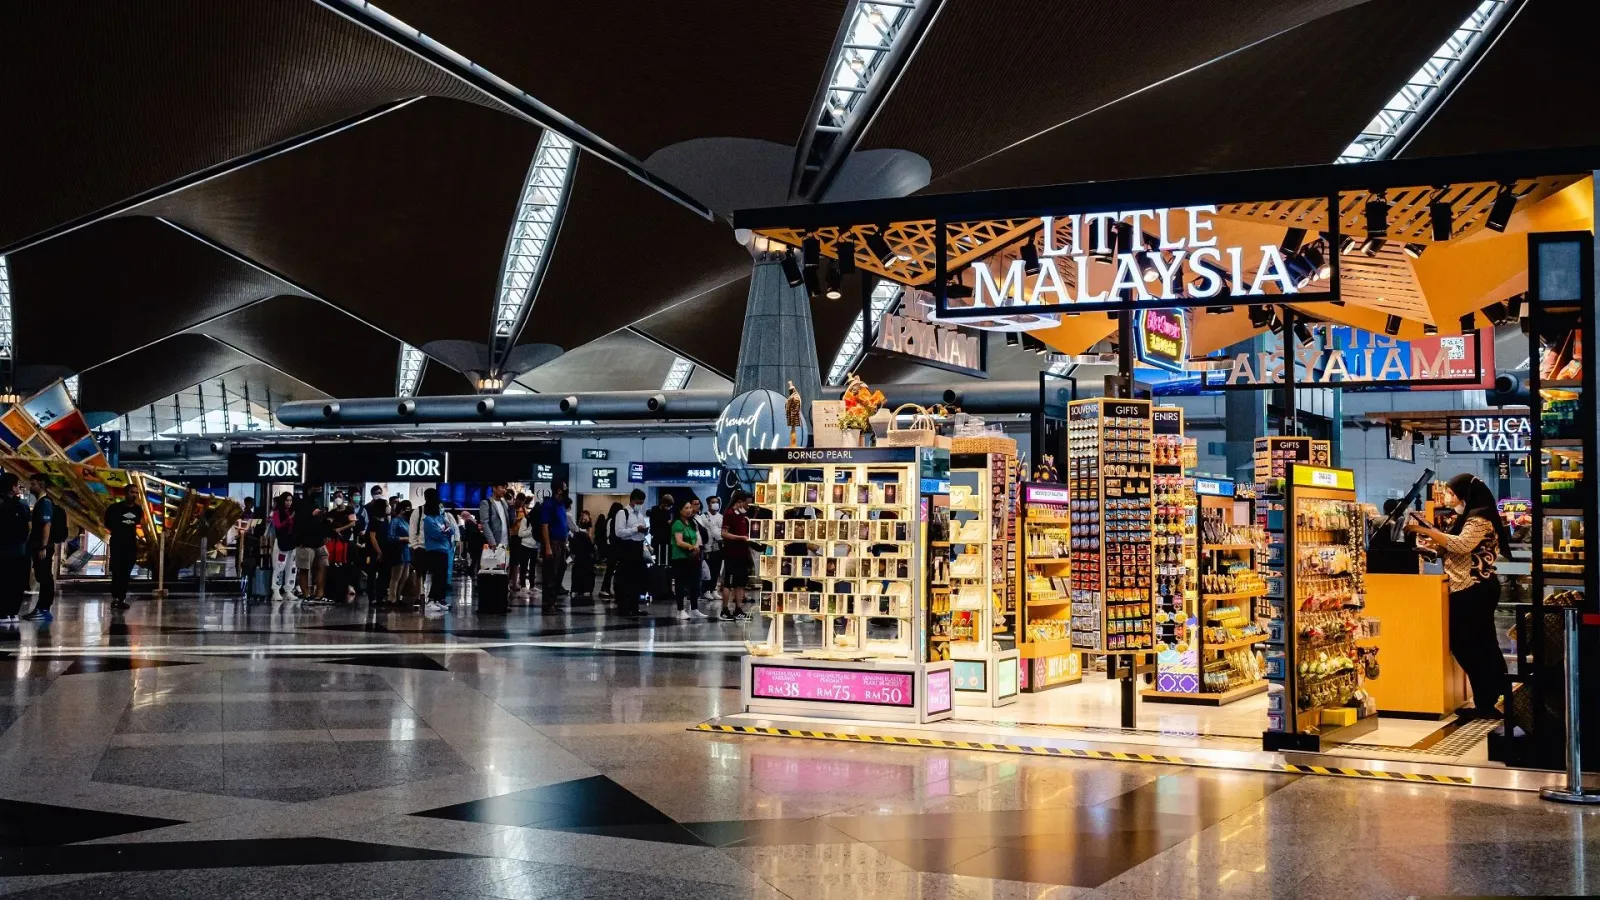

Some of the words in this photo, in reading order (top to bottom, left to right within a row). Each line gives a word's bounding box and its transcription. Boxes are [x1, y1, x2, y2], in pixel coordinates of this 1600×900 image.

[1040, 204, 1218, 256] LITTLE
[971, 244, 1300, 308] MALAYSIA
[1115, 405, 1139, 415] GIFTS
[715, 401, 766, 437] Around
[1280, 441, 1300, 449] GIFTS
[1470, 433, 1529, 450] MAL
[787, 451, 824, 460] BORNEO
[826, 450, 853, 459] PEARL
[258, 460, 299, 477] DIOR
[396, 459, 441, 477] DIOR
[768, 682, 799, 697] RM38
[817, 685, 850, 701] RM75
[865, 688, 902, 703] RM50
